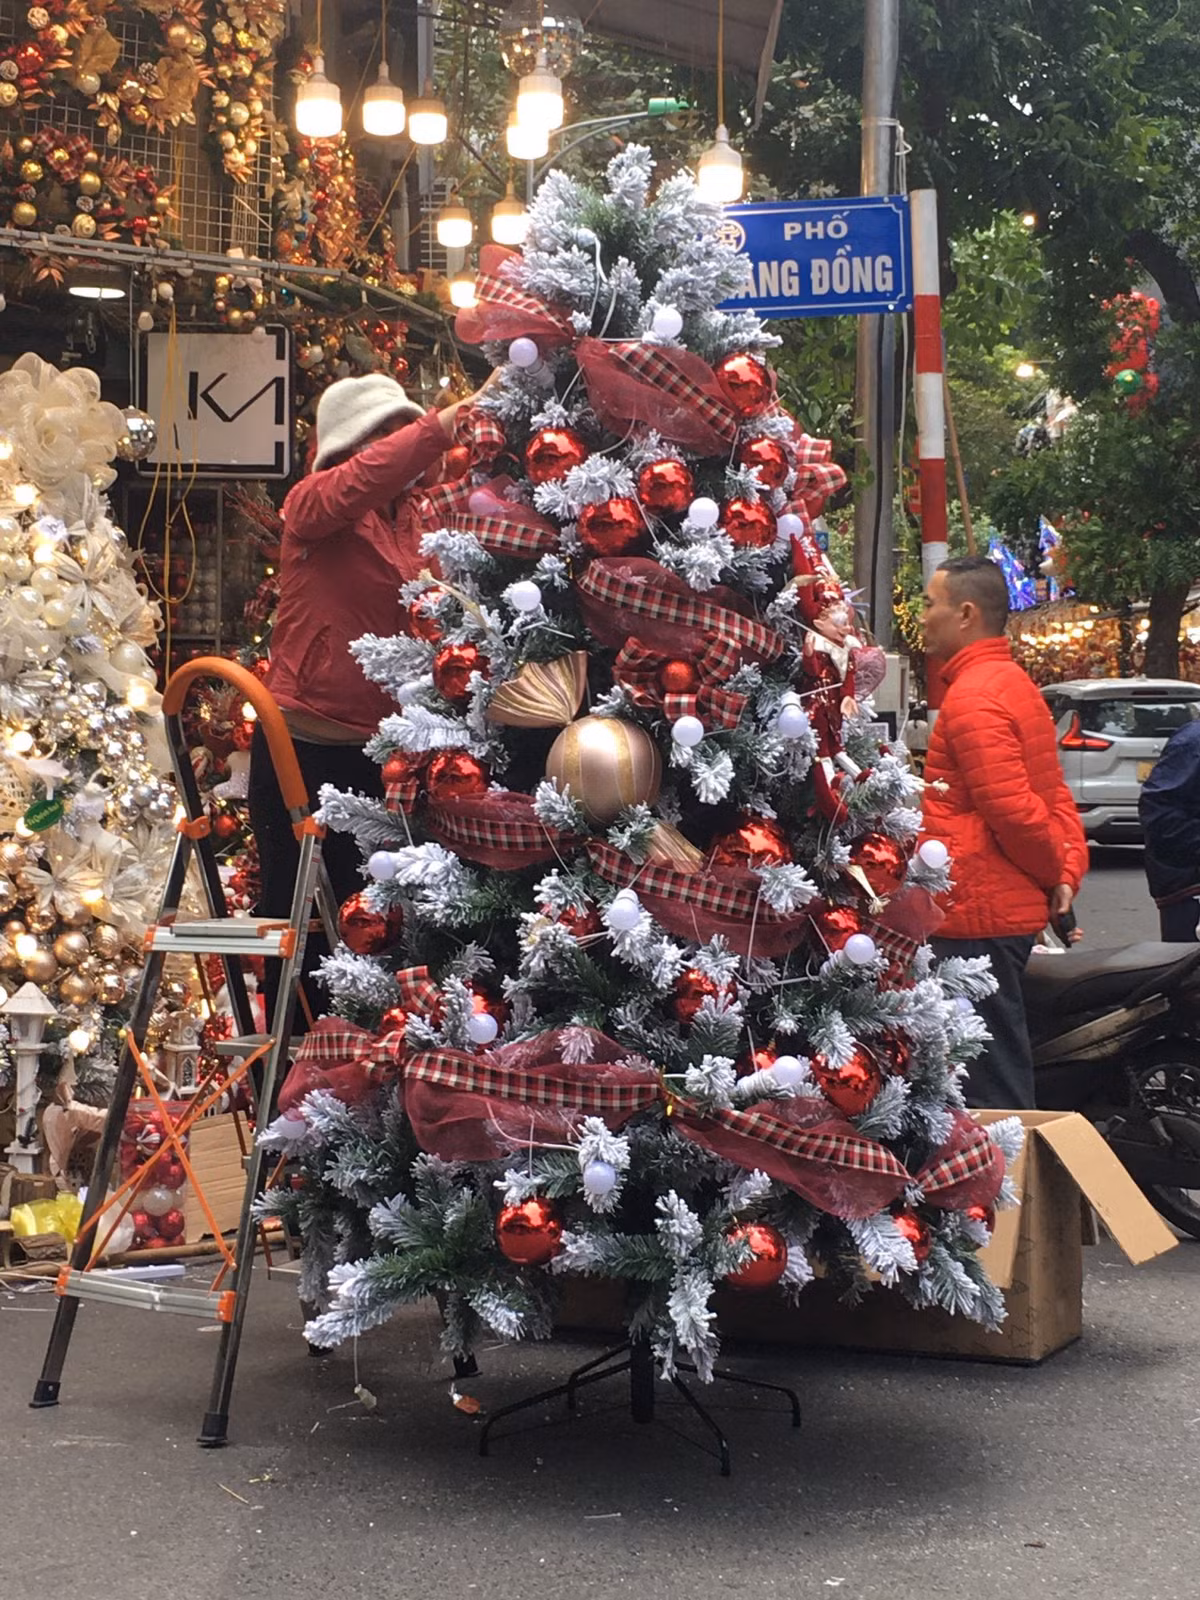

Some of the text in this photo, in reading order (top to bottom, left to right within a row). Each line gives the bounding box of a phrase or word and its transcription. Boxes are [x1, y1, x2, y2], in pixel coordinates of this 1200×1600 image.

[783, 210, 850, 241] PHỐ
[727, 244, 894, 299] ANG ĐỒNG
